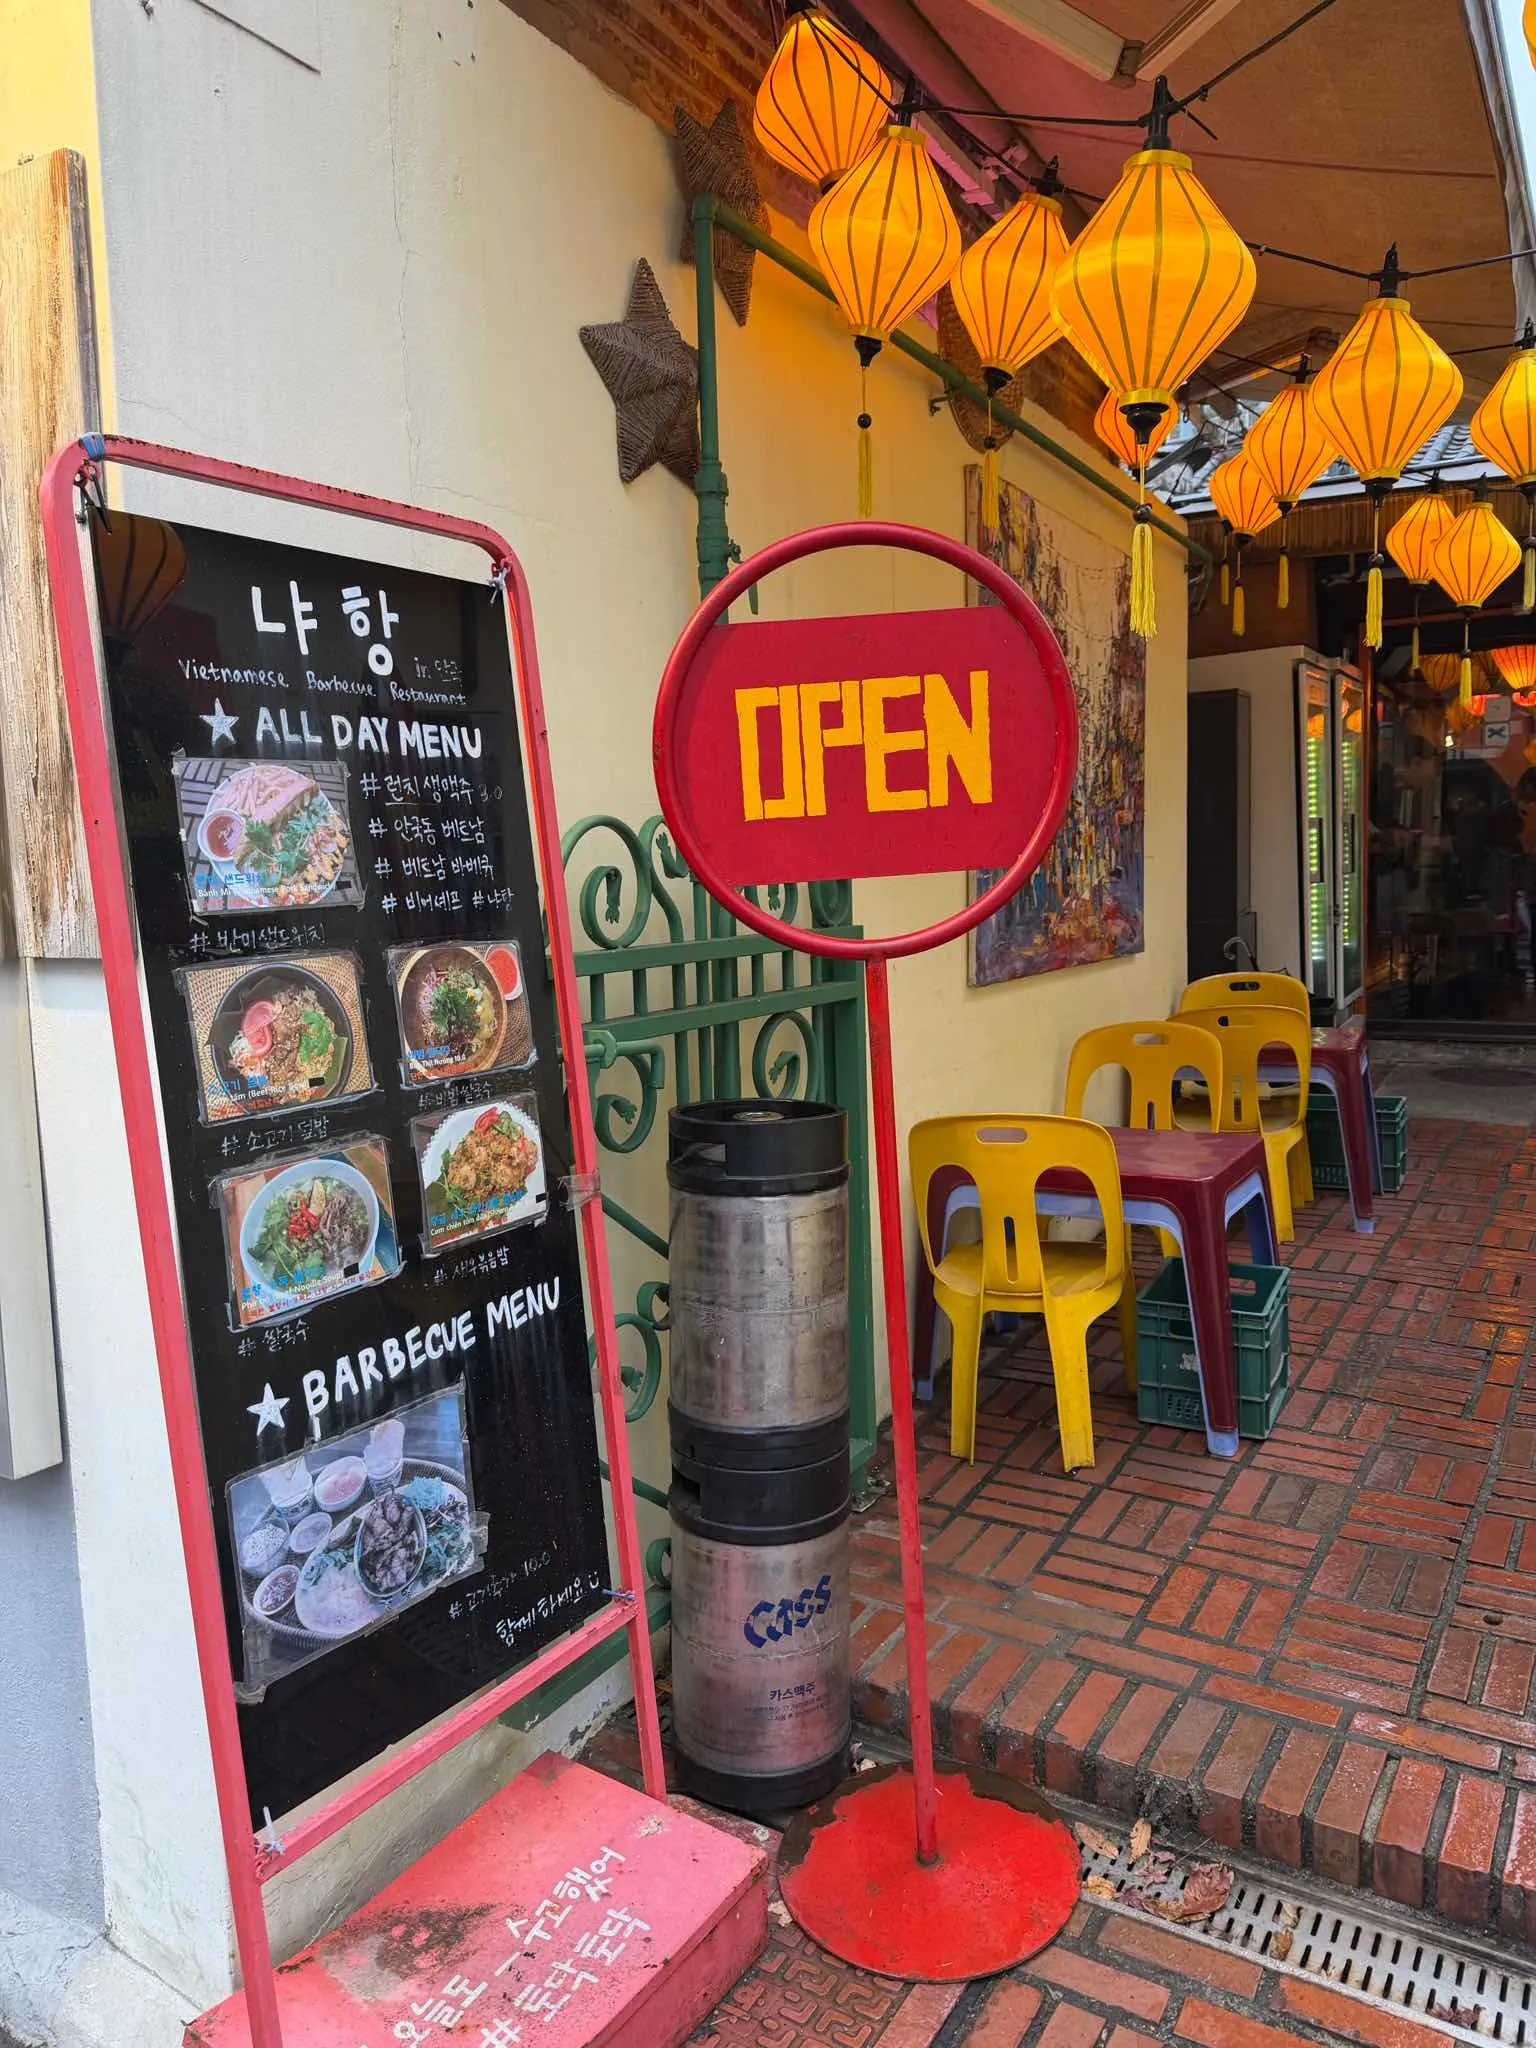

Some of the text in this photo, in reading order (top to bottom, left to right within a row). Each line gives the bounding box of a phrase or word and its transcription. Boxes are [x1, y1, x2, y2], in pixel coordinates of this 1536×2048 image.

[250, 580, 400, 676] 냐항
[178, 657, 289, 689] Vietnamese
[306, 669, 377, 696] Barbecue
[255, 706, 484, 760] ALL DAY MENU
[734, 669, 993, 822] OPEN
[302, 1276, 561, 1420] BARBECUE MENU
[769, 1681, 816, 1702] 카스맥주
[504, 1845, 627, 1945] 수고했어
